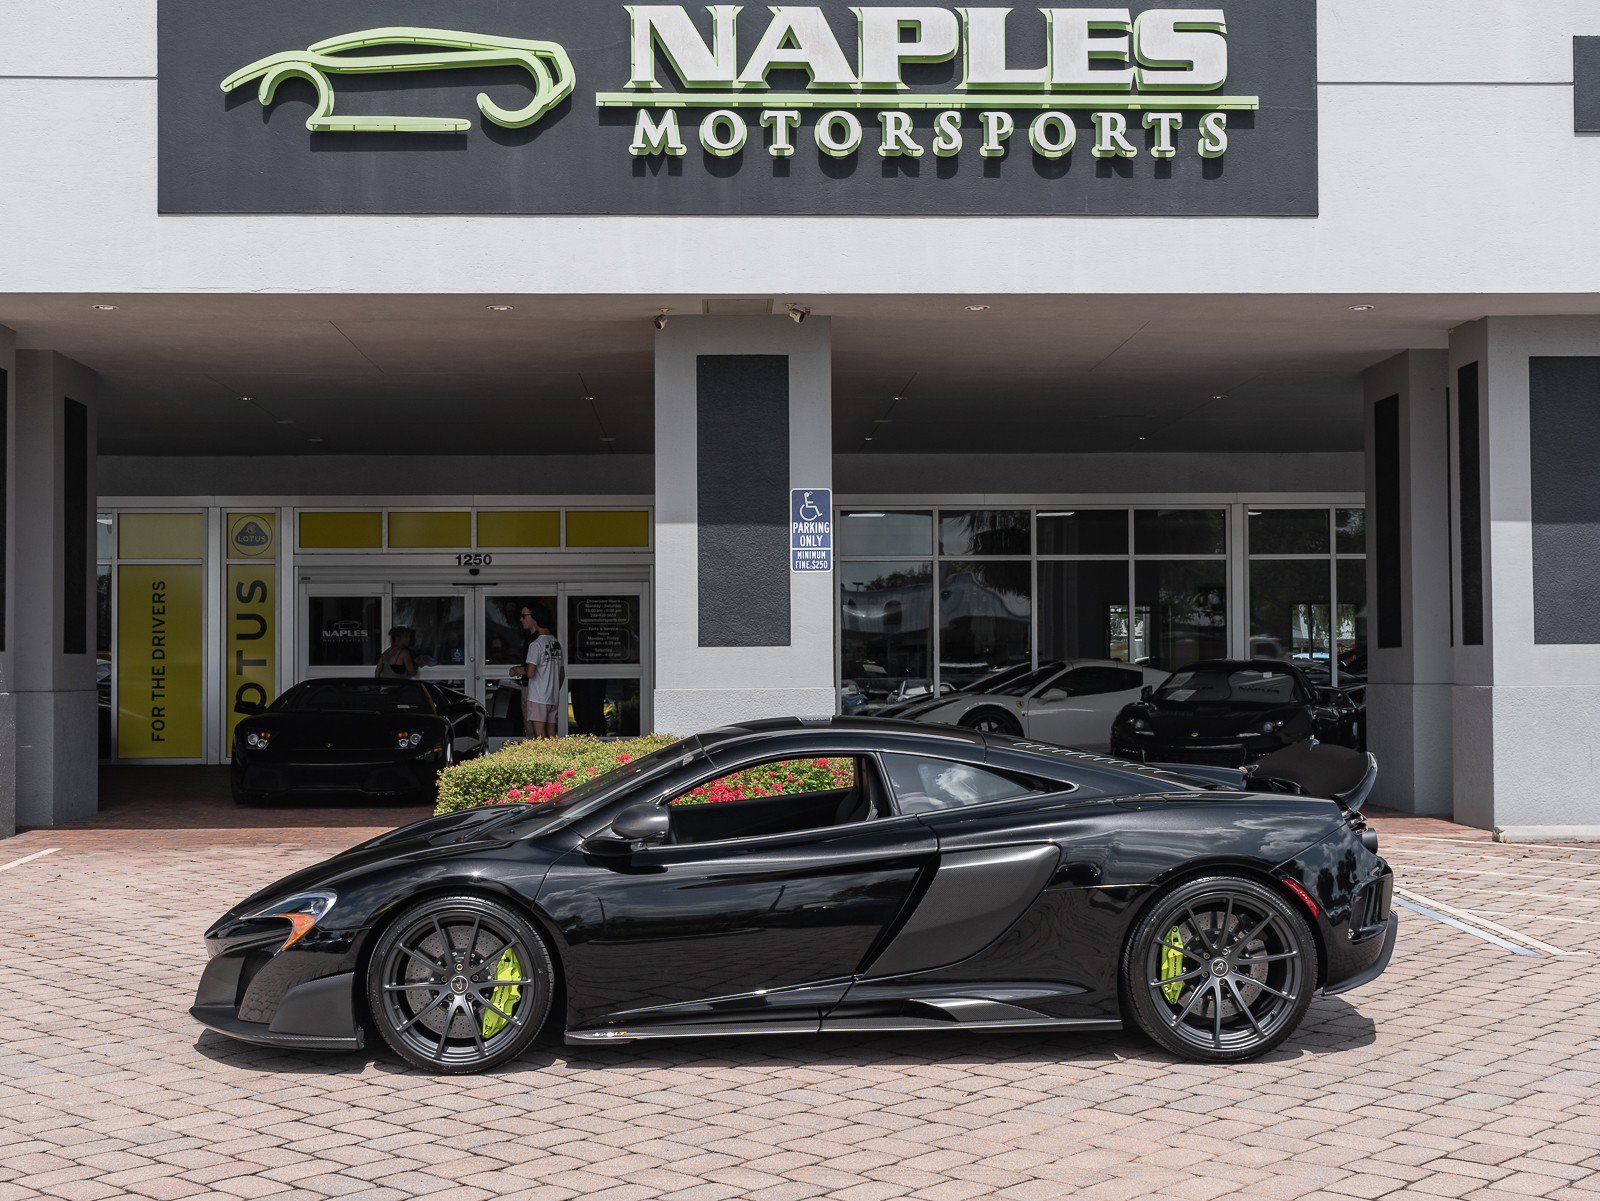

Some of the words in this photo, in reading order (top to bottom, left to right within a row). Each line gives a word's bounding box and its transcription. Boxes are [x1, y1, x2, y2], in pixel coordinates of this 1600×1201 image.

[623, 4, 1228, 90] NAPLES
[628, 107, 1229, 158] MOTORSPORTS
[793, 522, 830, 534] PARKING
[800, 535, 823, 547] ONLY
[456, 553, 493, 566] 1250
[795, 560, 810, 569] FINE
[812, 560, 828, 569] $250
[797, 551, 826, 559] MINIMUM
[152, 580, 166, 660] DRIVERS
[235, 580, 268, 710] OTUS
[322, 629, 369, 637] NAPLES
[152, 666, 166, 701] THE
[152, 706, 166, 742] FOR
